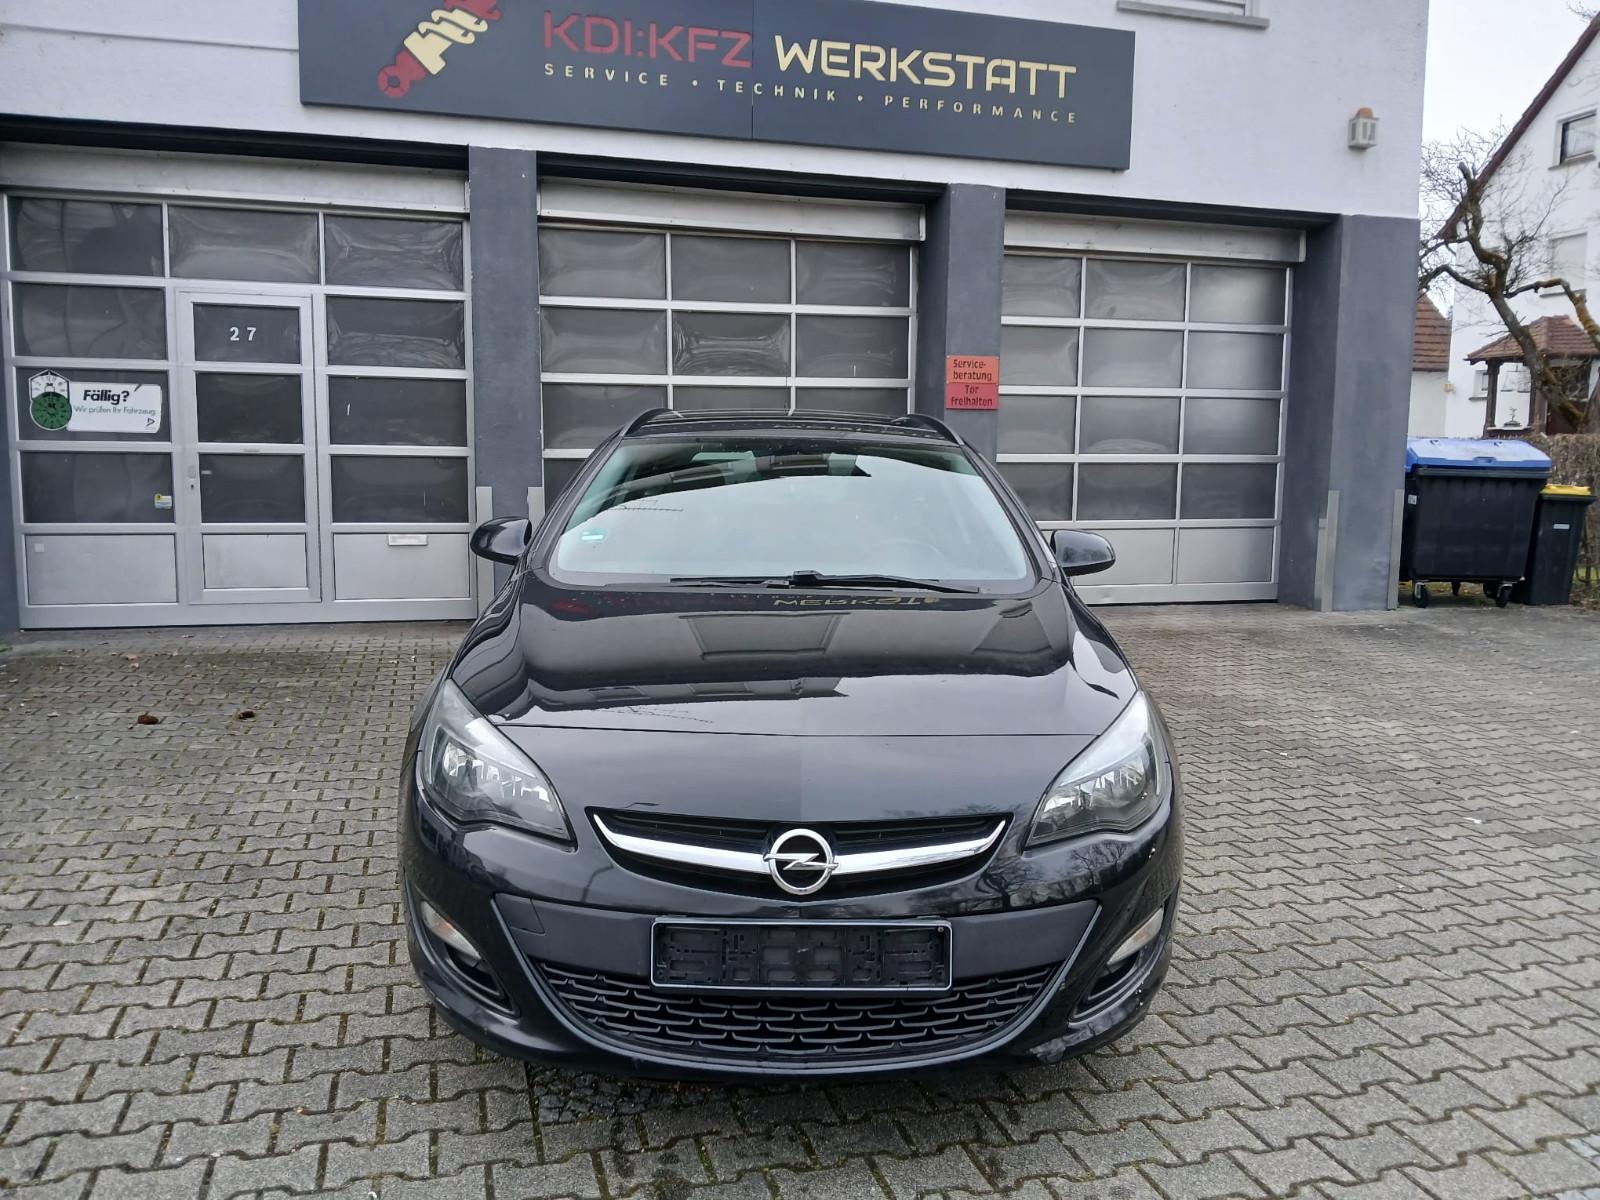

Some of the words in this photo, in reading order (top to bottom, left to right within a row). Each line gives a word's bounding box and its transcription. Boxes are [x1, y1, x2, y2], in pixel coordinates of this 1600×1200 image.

[543, 10, 752, 69] KDI:KFZ
[774, 34, 1077, 99] WERKSTATT
[544, 63, 668, 87] SERVICE
[717, 79, 836, 102] TECHNIK
[884, 94, 1077, 123] PERFORMANCE
[953, 359, 987, 369] Service-
[953, 370, 992, 382] beratung
[964, 384, 979, 394] Tor
[83, 389, 130, 405] Fällig?
[73, 405, 87, 413] Wir
[88, 405, 111, 414] prüfen
[123, 406, 156, 417] Fahrzeug
